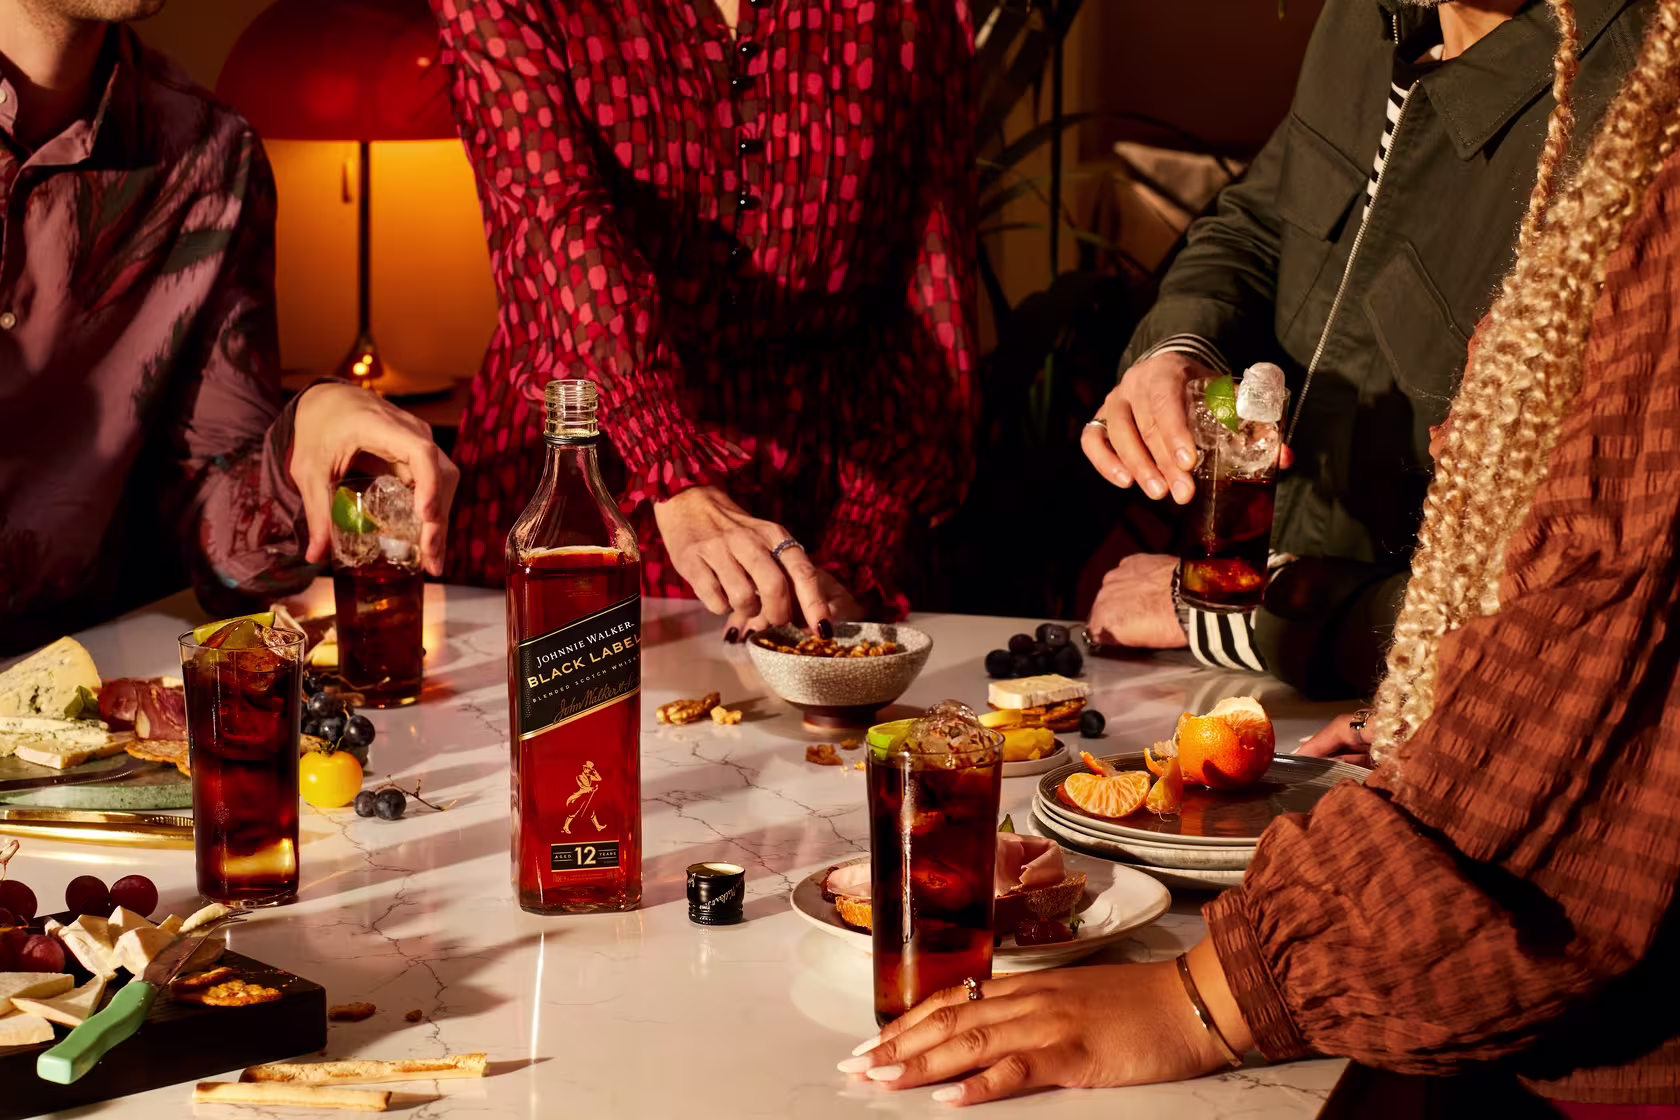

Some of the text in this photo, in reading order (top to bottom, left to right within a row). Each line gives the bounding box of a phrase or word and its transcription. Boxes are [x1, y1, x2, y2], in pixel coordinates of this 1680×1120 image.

[526, 656, 586, 689] BLACK
[588, 634, 641, 663] LABEL
[536, 640, 585, 668] JOHNNIE
[532, 684, 570, 703] BLENDED
[574, 669, 607, 686] SCOTCH
[574, 846, 597, 866] 12
